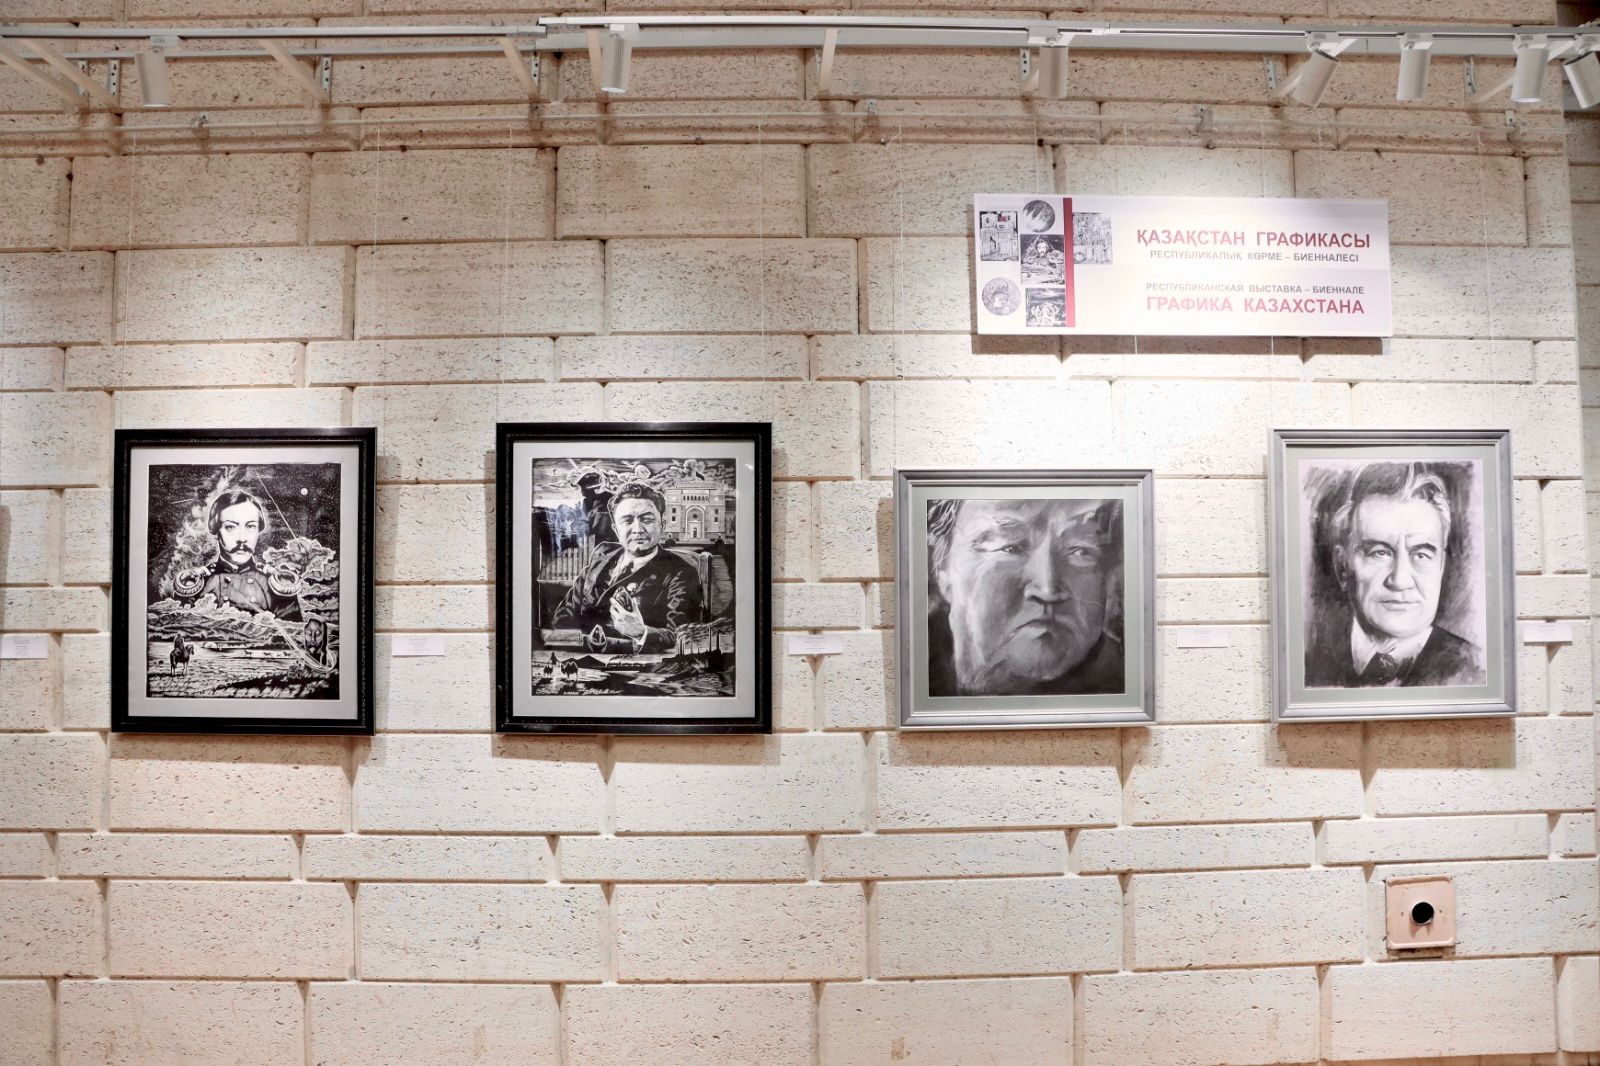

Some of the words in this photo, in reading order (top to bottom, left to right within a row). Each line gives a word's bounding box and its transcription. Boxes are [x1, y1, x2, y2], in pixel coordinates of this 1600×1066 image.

[1137, 229, 1245, 247] ҚАЗАҚСТАН
[1256, 232, 1370, 248] ГРАФИКАСЫ
[1247, 252, 1282, 261] КӨРМЕ
[1294, 253, 1359, 262] БИЕННАЛЕСІ
[1146, 283, 1244, 292] РЕСПУБЛИКАНСКАЯ
[1249, 284, 1302, 293] ВЫСТАВКА
[1312, 285, 1365, 295] БИЕННАЛЕ
[1146, 296, 1233, 312] ГРАФИКА
[1244, 298, 1364, 314] КАЗАХСТАНА
